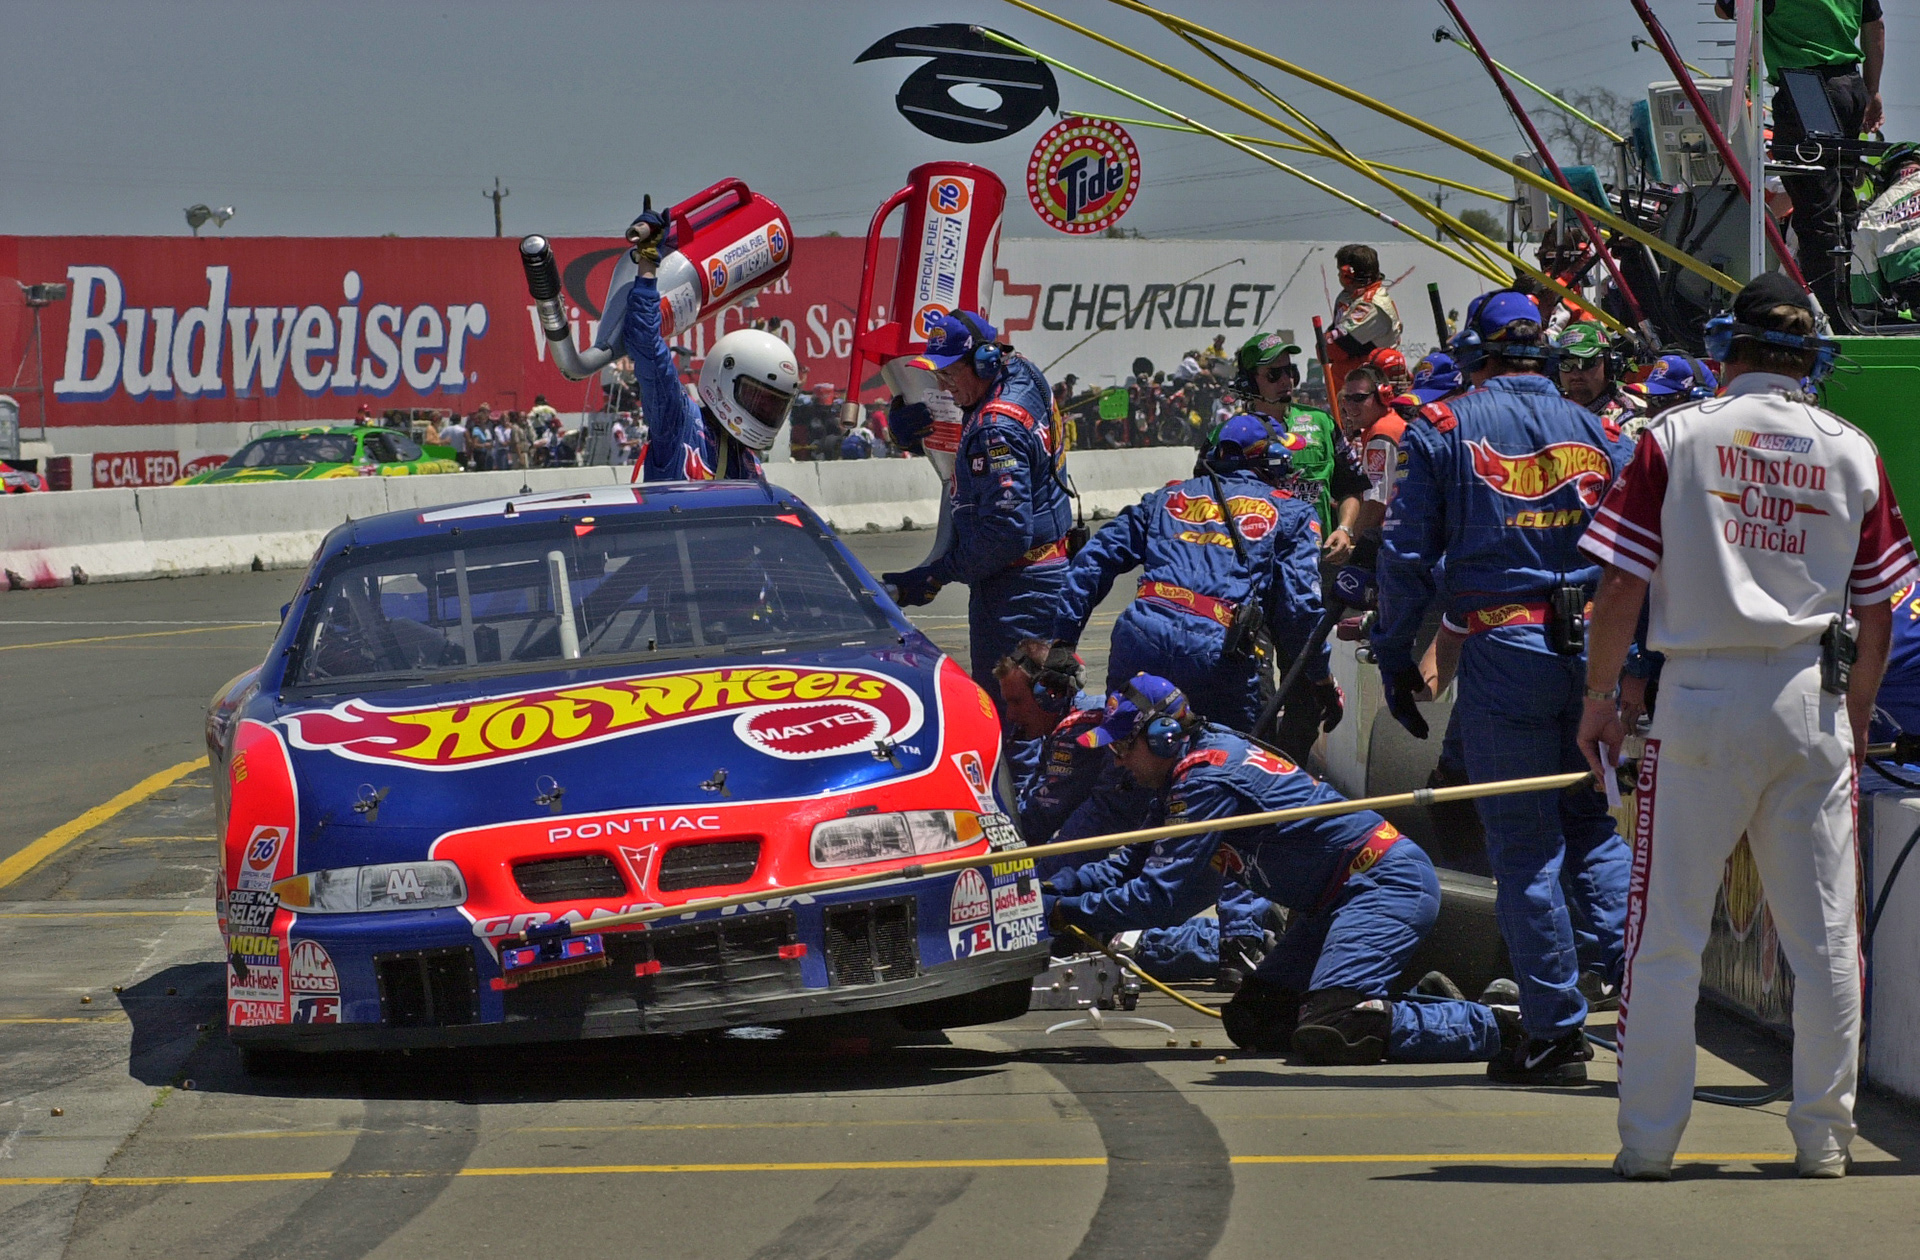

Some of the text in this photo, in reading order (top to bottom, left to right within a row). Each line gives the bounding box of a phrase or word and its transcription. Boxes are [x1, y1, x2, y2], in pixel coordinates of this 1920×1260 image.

[938, 183, 960, 210] 76
[1056, 155, 1125, 222] Tide
[724, 234, 766, 265] OFFICIAL FUEL
[770, 231, 784, 254] 76
[919, 216, 939, 301] OFFICIAL FUEL
[712, 264, 725, 289] 76
[1042, 283, 1276, 332] CHEVROLET
[53, 265, 488, 400] Budweiser
[1754, 433, 1809, 453] NASCAR
[110, 455, 178, 486] CAL FED
[1500, 446, 1608, 497] Hot Wheels
[1715, 445, 1827, 492] Winston
[1740, 485, 1796, 527] Cup
[1723, 518, 1807, 555] Official
[387, 668, 888, 761] Hot Wheels
[750, 711, 875, 742] MATTEL
[900, 744, 921, 757] TM
[1637, 743, 1659, 790] Cup
[549, 814, 722, 845] PONTIAC
[985, 824, 1022, 846] SELECT
[1628, 797, 1651, 893] Winston
[250, 836, 280, 862] 76
[229, 890, 256, 904] EXIDE
[953, 870, 988, 909] MAC
[229, 903, 275, 926] SELECT
[952, 901, 990, 921] TOOLS
[229, 934, 280, 956] MOOG
[238, 925, 271, 934] BATTERIES
[954, 922, 992, 960] JE
[996, 914, 1046, 952] CRANE
[291, 942, 335, 979] MAC
[291, 977, 336, 990] TOOLS
[229, 1001, 285, 1027] CRANE
[292, 997, 339, 1024] JE
